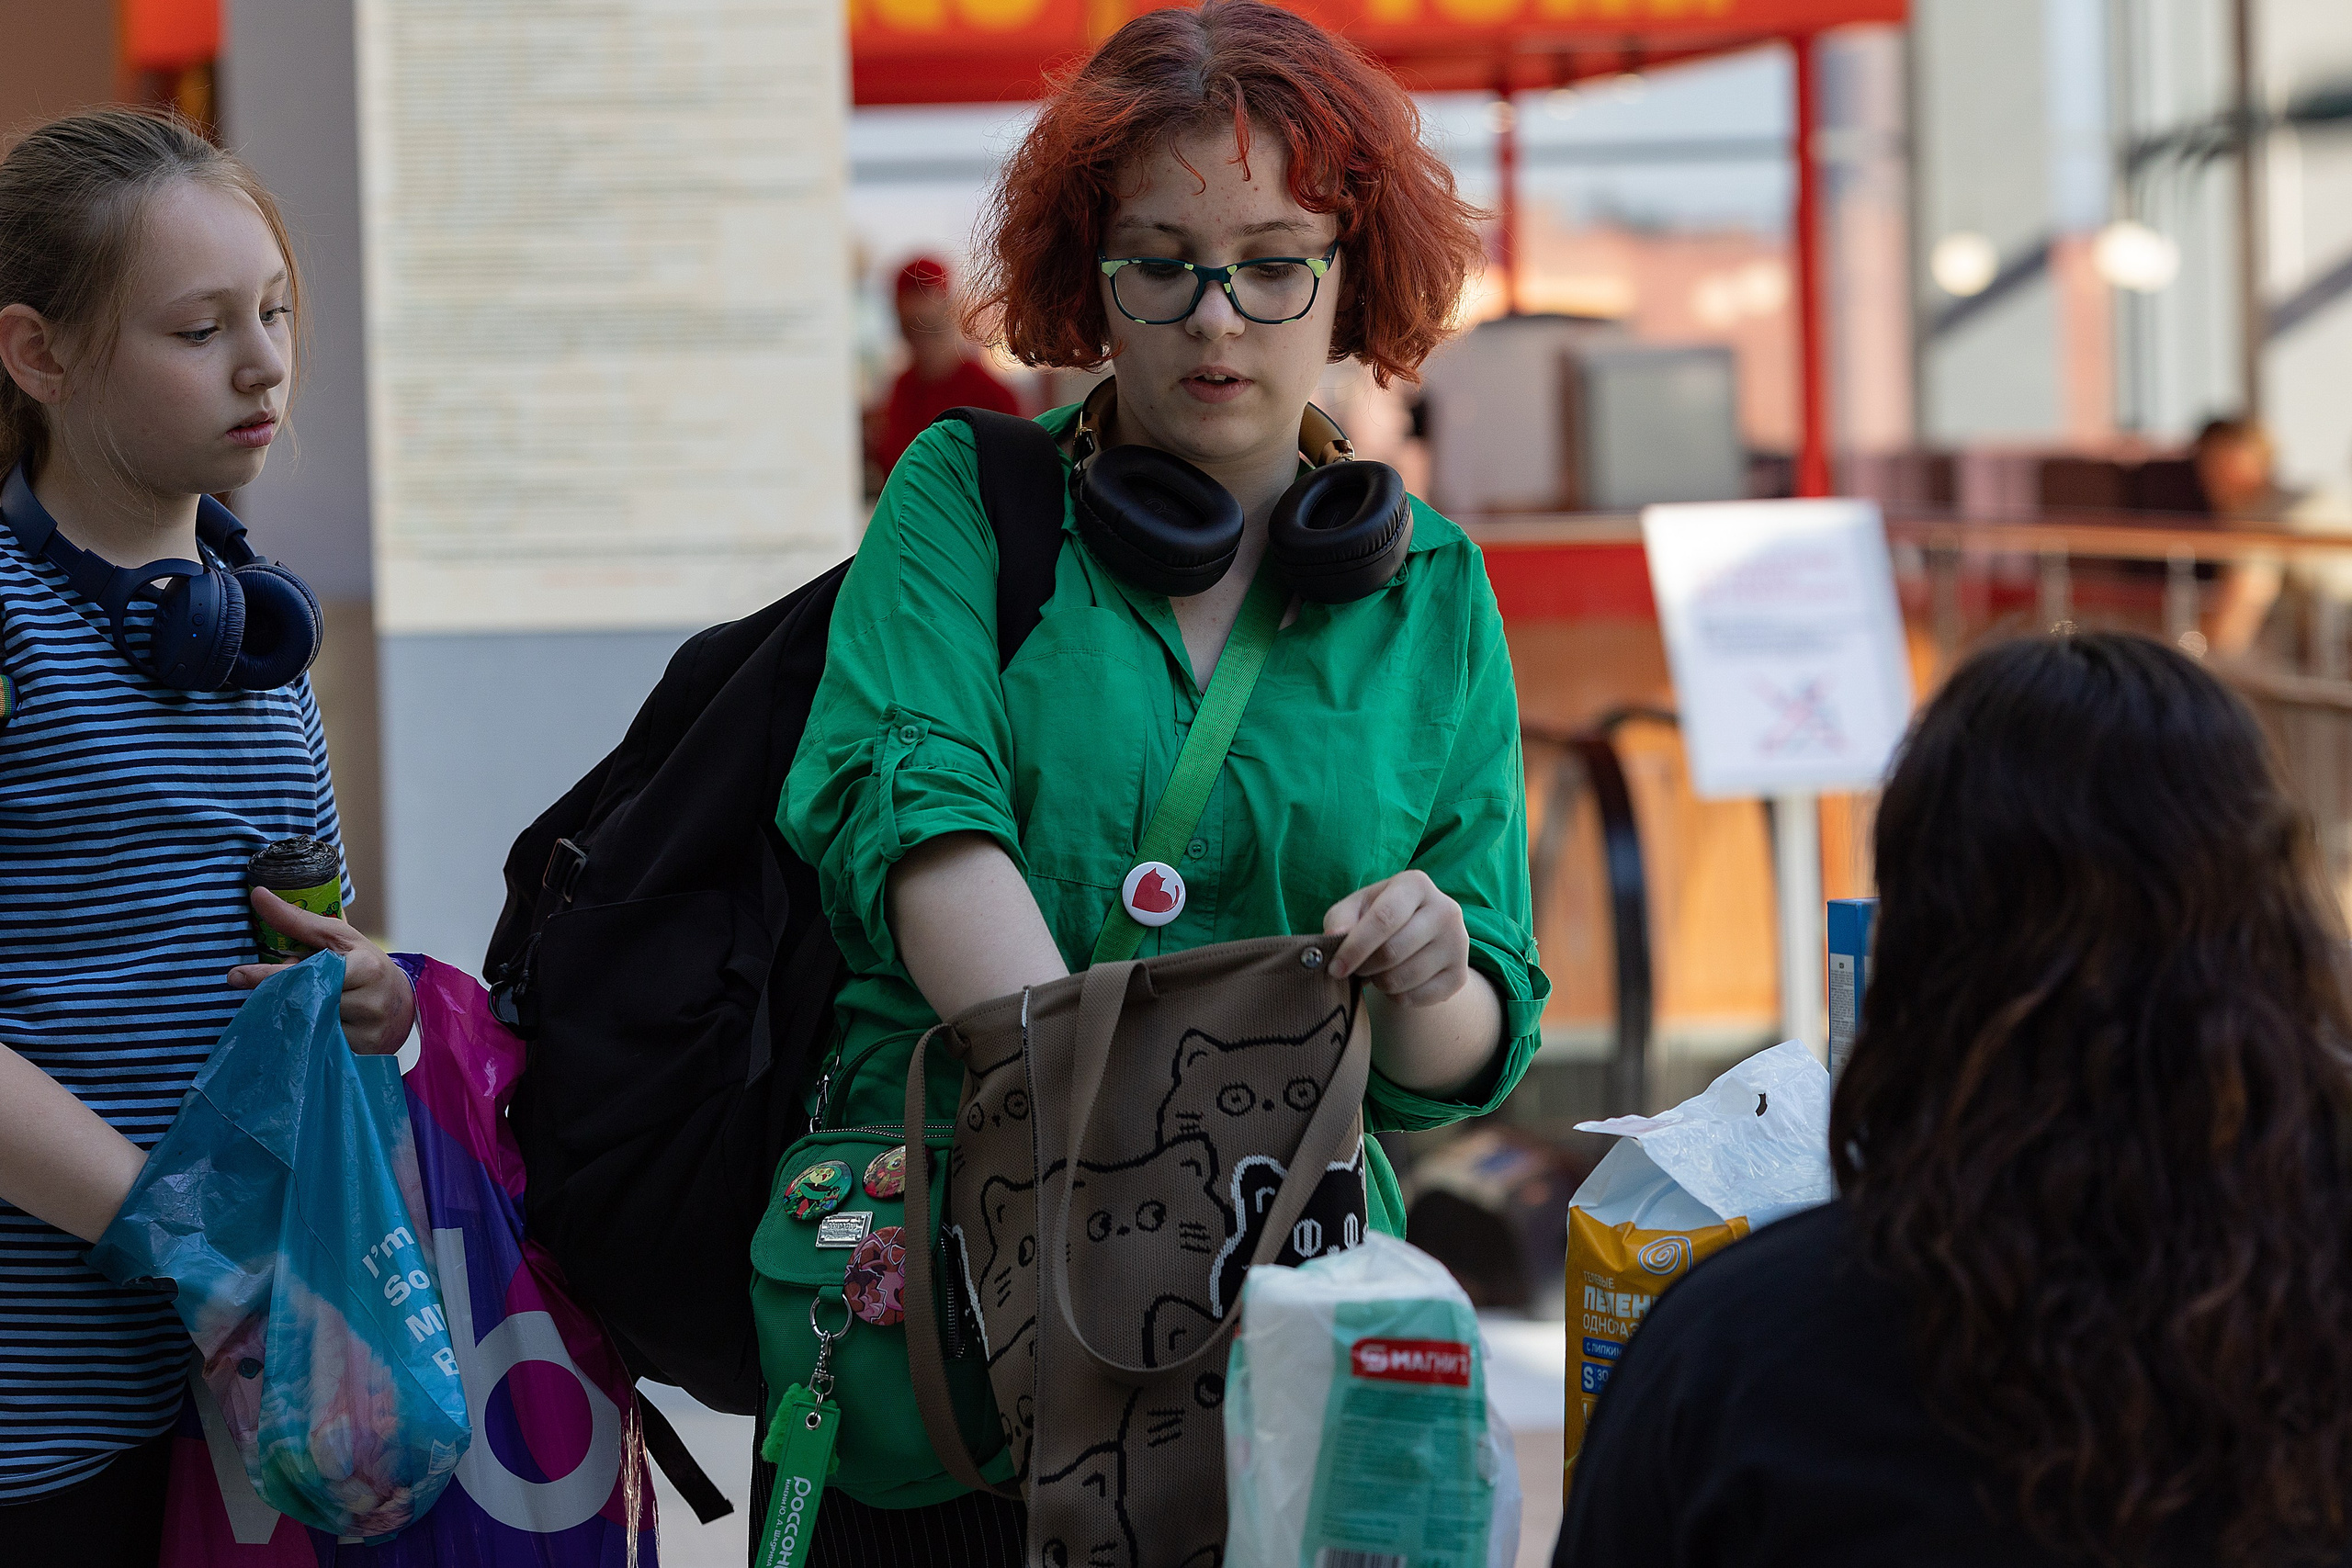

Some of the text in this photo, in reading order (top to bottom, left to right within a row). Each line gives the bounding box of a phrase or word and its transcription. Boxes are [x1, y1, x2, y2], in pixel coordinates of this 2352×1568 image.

[362, 1226, 414, 1279] I'm
[384, 1269, 430, 1307] So
[1584, 1285, 1660, 1319] ПЕЛЕН
[1583, 1366, 1596, 1390] S
